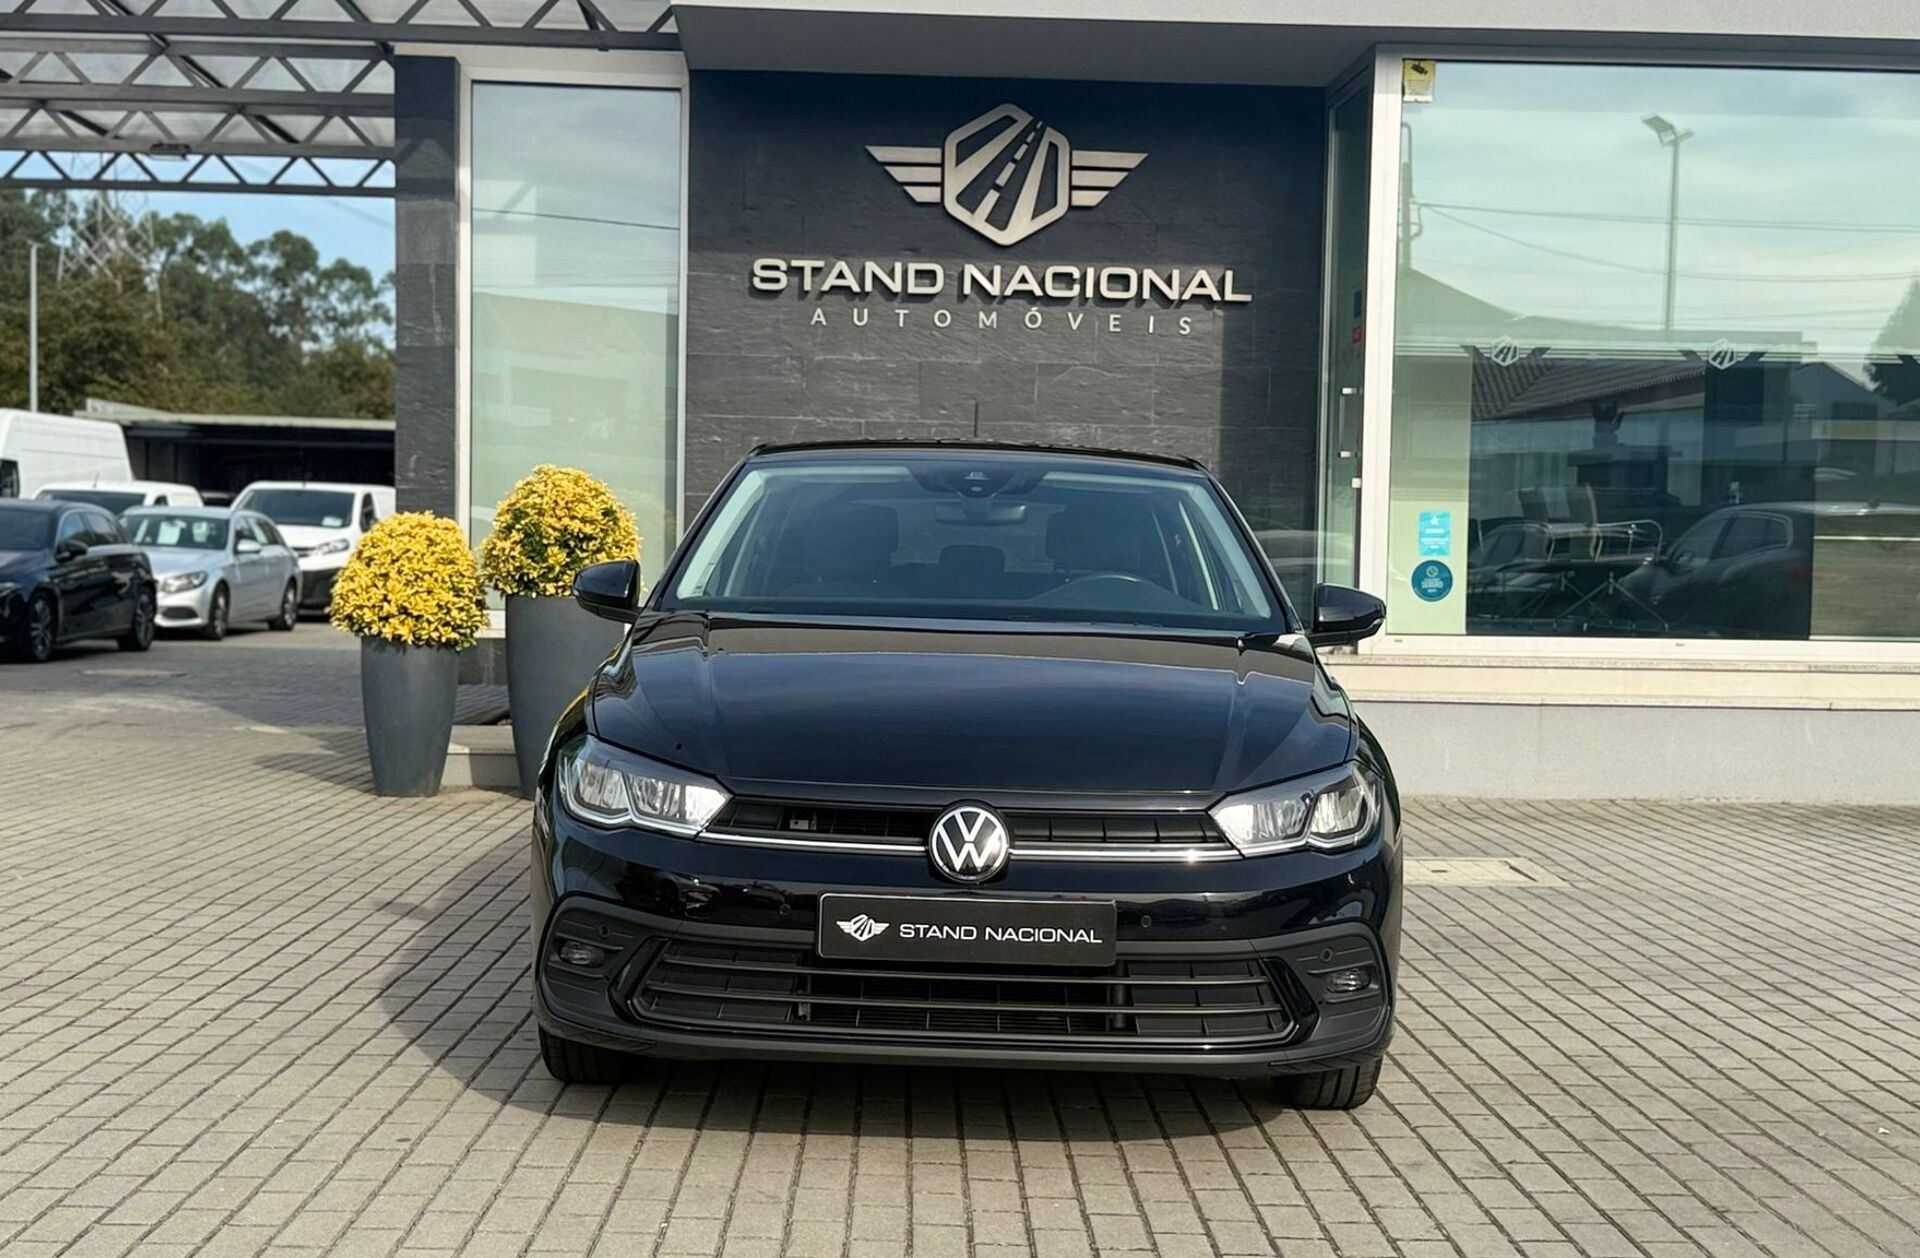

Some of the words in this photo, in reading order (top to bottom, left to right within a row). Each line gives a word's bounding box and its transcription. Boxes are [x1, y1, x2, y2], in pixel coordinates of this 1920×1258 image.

[752, 258, 945, 295] STAND
[963, 263, 1252, 302] NACIONAL
[810, 307, 1192, 335] AUTOMÓVEIS
[899, 923, 977, 941] STAND
[984, 927, 1103, 944] NACIONAL
